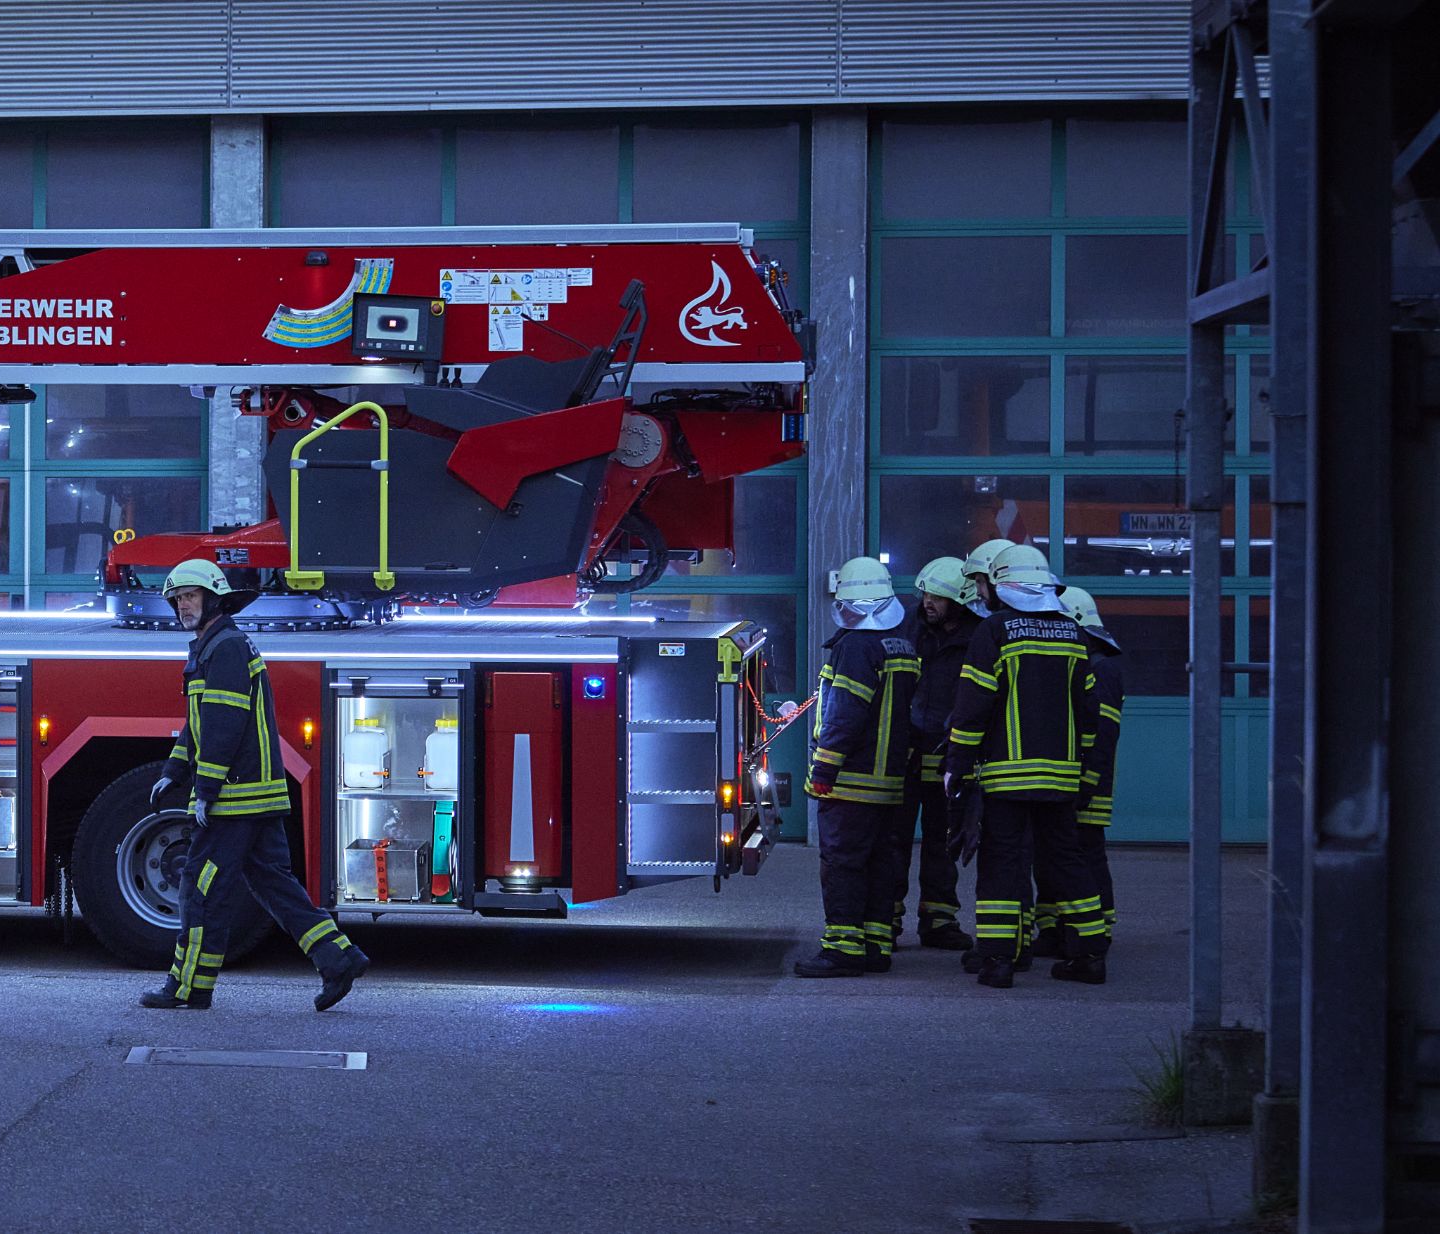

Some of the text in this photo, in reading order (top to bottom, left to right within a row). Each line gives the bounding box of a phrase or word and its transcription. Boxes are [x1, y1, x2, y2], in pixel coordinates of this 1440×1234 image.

[1130, 516, 1149, 531] WN
[1158, 516, 1175, 531] WN
[1004, 618, 1077, 631] FEUERWEHR
[1007, 627, 1078, 640] WAIBLINGEN
